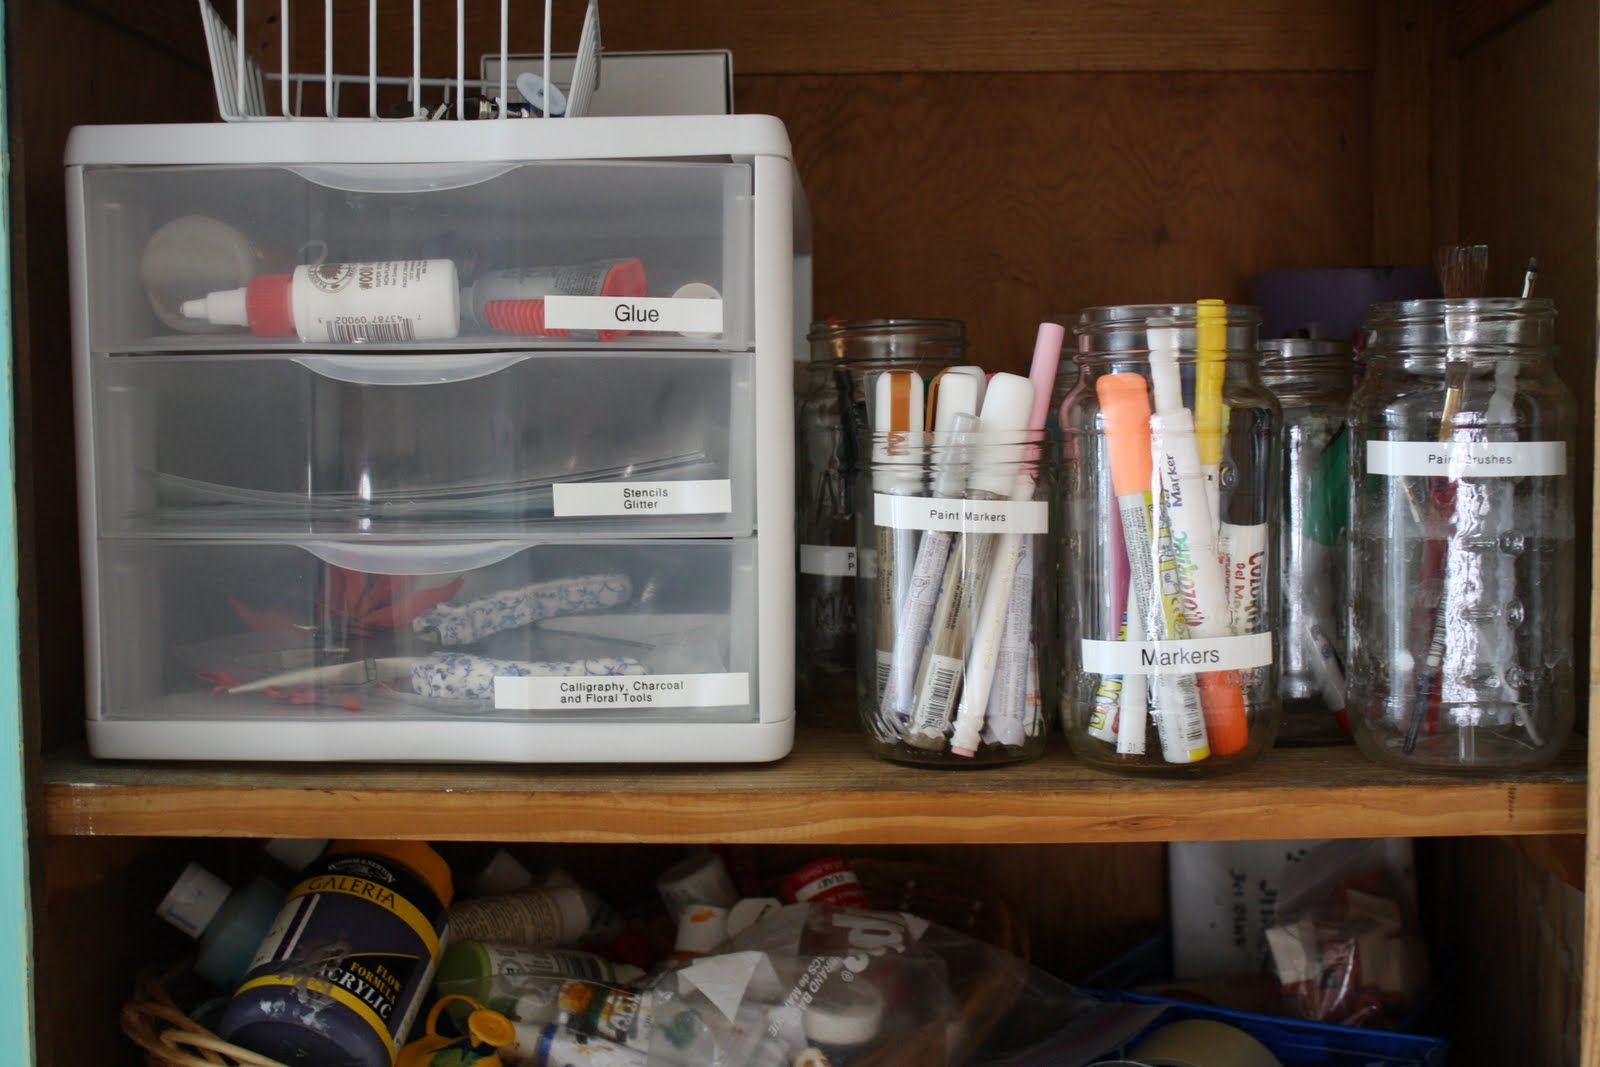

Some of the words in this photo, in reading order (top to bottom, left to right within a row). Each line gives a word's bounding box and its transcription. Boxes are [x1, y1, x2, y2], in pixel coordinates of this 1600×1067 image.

[614, 303, 660, 323] Glue
[1428, 454, 1457, 464] Pain
[1166, 453, 1183, 508] Marker
[623, 488, 668, 498] Stencils
[623, 500, 658, 510] Glitter
[930, 509, 960, 521] Paint
[964, 512, 1006, 522] Markers
[1141, 648, 1220, 666] Markers
[560, 682, 629, 693] Calligraphy,
[633, 680, 684, 691] Charcoal
[560, 694, 580, 704] and
[586, 693, 618, 702] Floral
[623, 692, 652, 702] Tools
[308, 876, 396, 910] GALERIA
[350, 962, 396, 1005] FORMULA
[376, 962, 402, 993] FLOW
